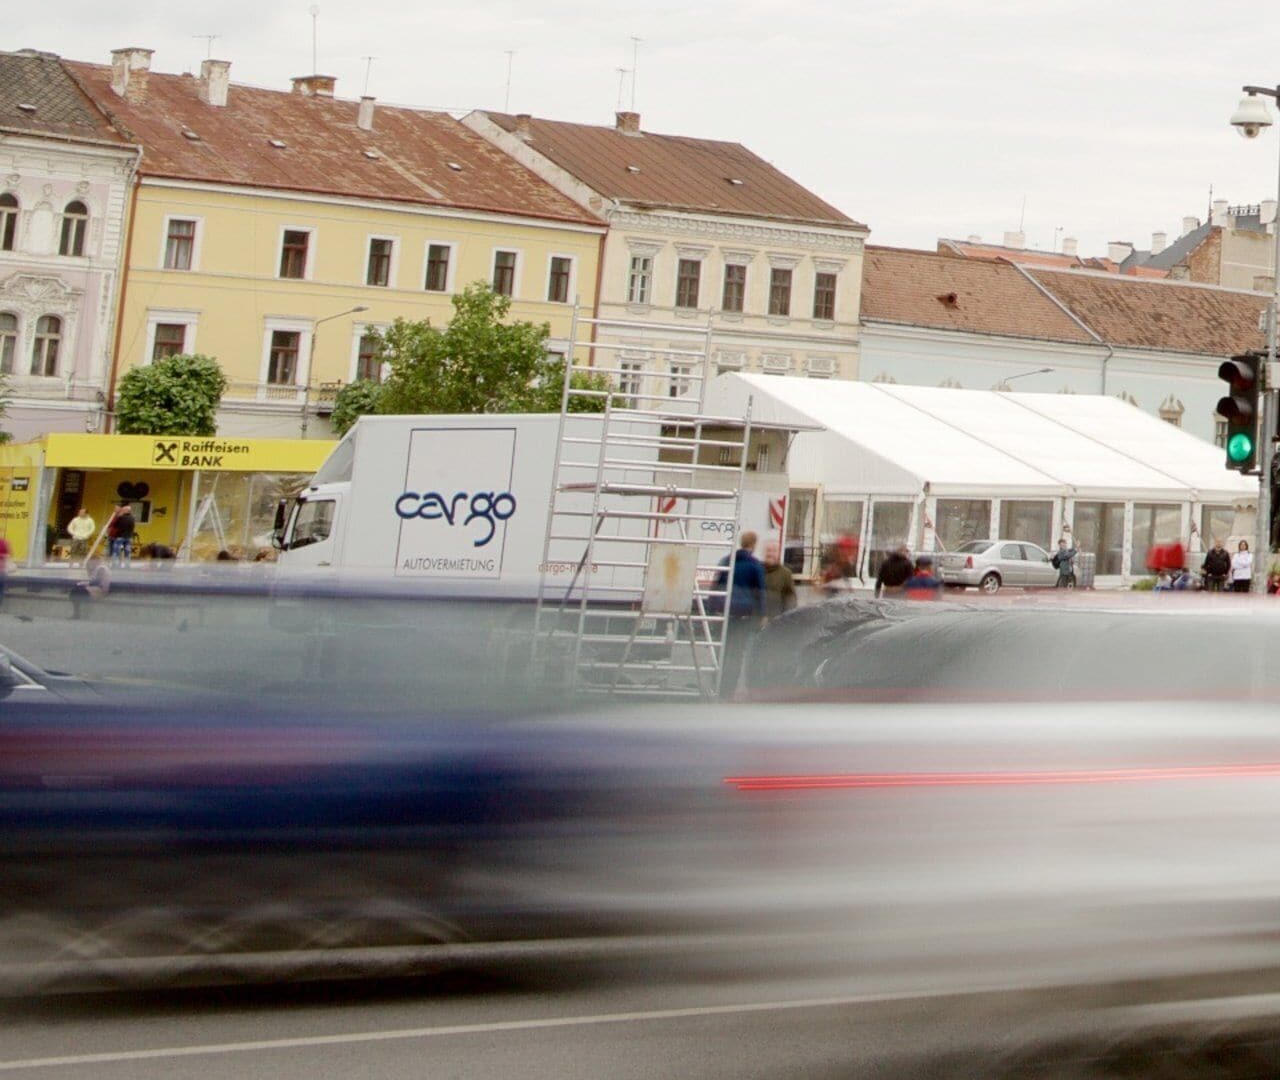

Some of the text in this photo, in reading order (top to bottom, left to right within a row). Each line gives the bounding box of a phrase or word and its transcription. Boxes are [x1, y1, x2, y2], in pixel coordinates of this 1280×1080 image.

[182, 441, 249, 453] Raiffeisen
[181, 455, 223, 467] BANK
[395, 492, 516, 547] cargo
[403, 558, 495, 571] AUTOVERMIETUNG
